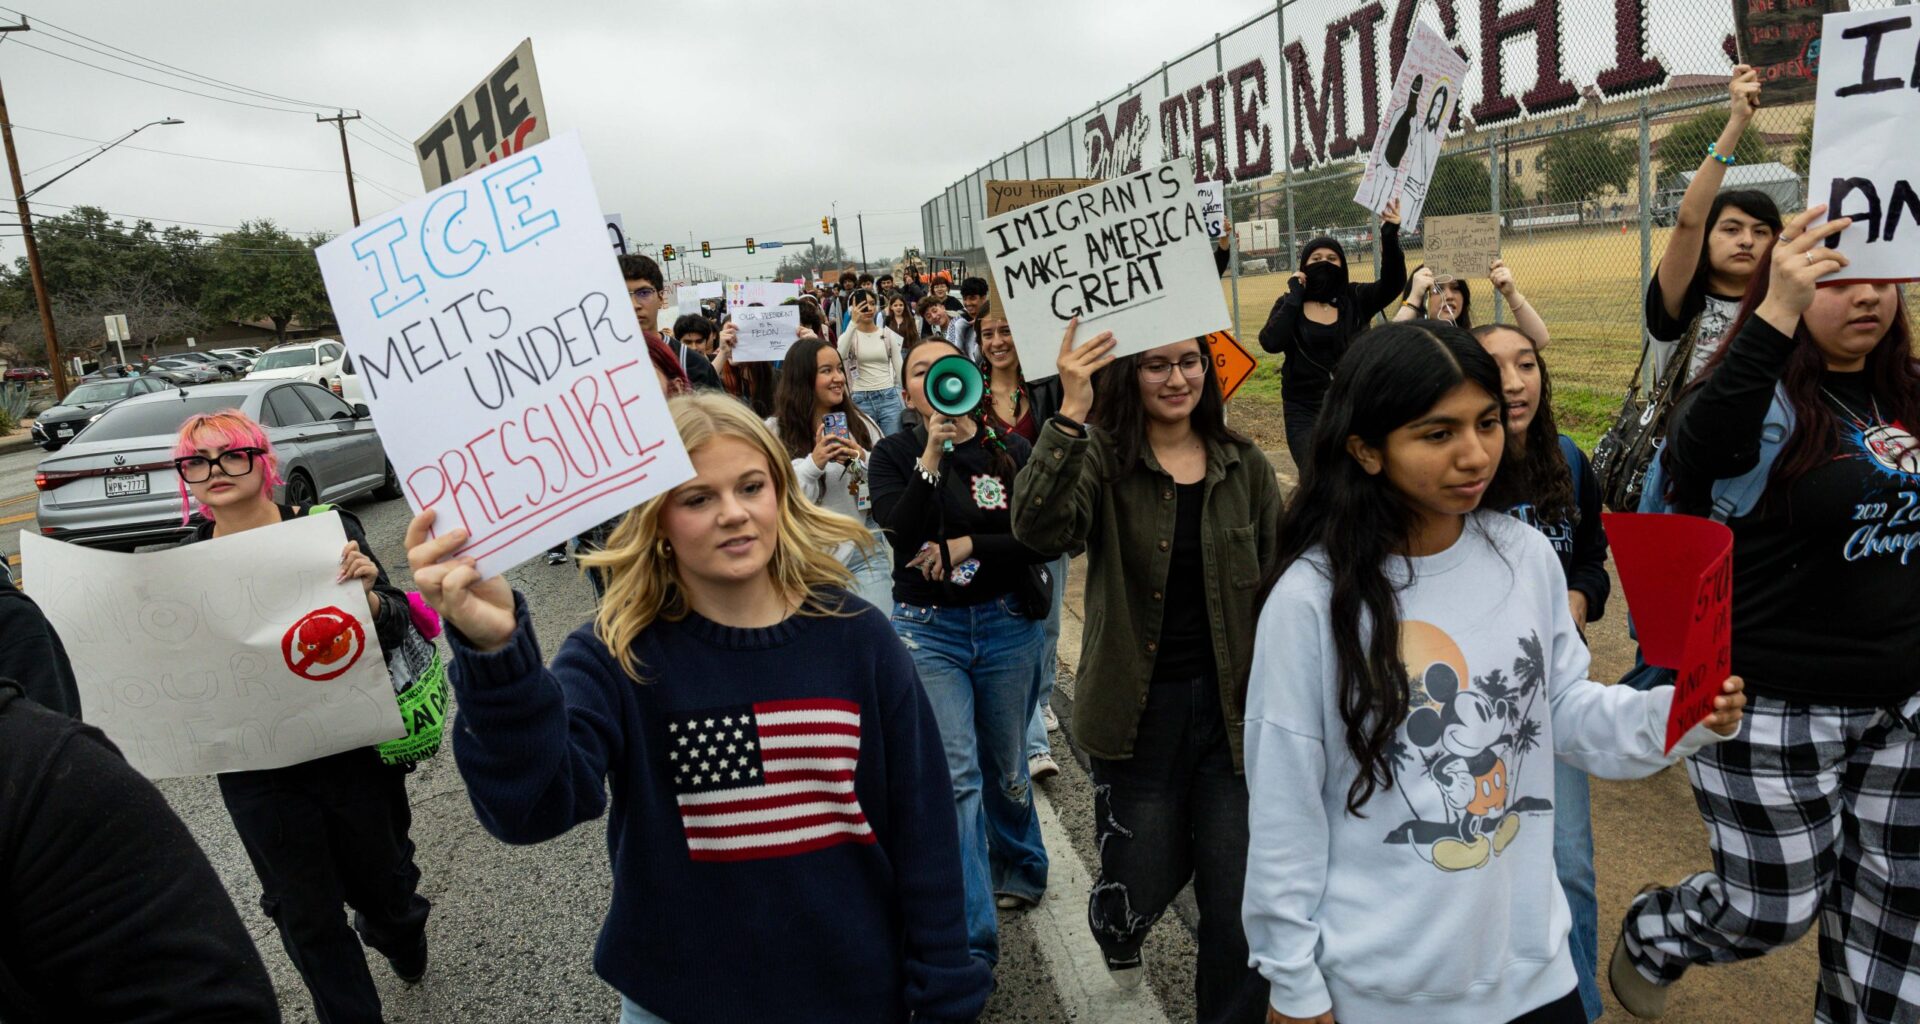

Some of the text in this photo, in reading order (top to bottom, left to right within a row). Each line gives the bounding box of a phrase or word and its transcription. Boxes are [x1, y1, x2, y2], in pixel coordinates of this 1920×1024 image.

[418, 54, 531, 187] THE
[351, 155, 559, 318] ICE
[986, 165, 1180, 259] IMIGRANTS
[991, 183, 1066, 212] you think
[1197, 189, 1214, 205] my
[1004, 202, 1204, 299] MAKE AMERICA
[1051, 251, 1164, 320] GREAT
[359, 289, 511, 400] MELTS
[464, 292, 633, 410] UNDER
[751, 328, 779, 337] FELON
[407, 360, 665, 538] PRESSURE
[40, 561, 313, 644] KNOW
[128, 684, 383, 772] NEMY
